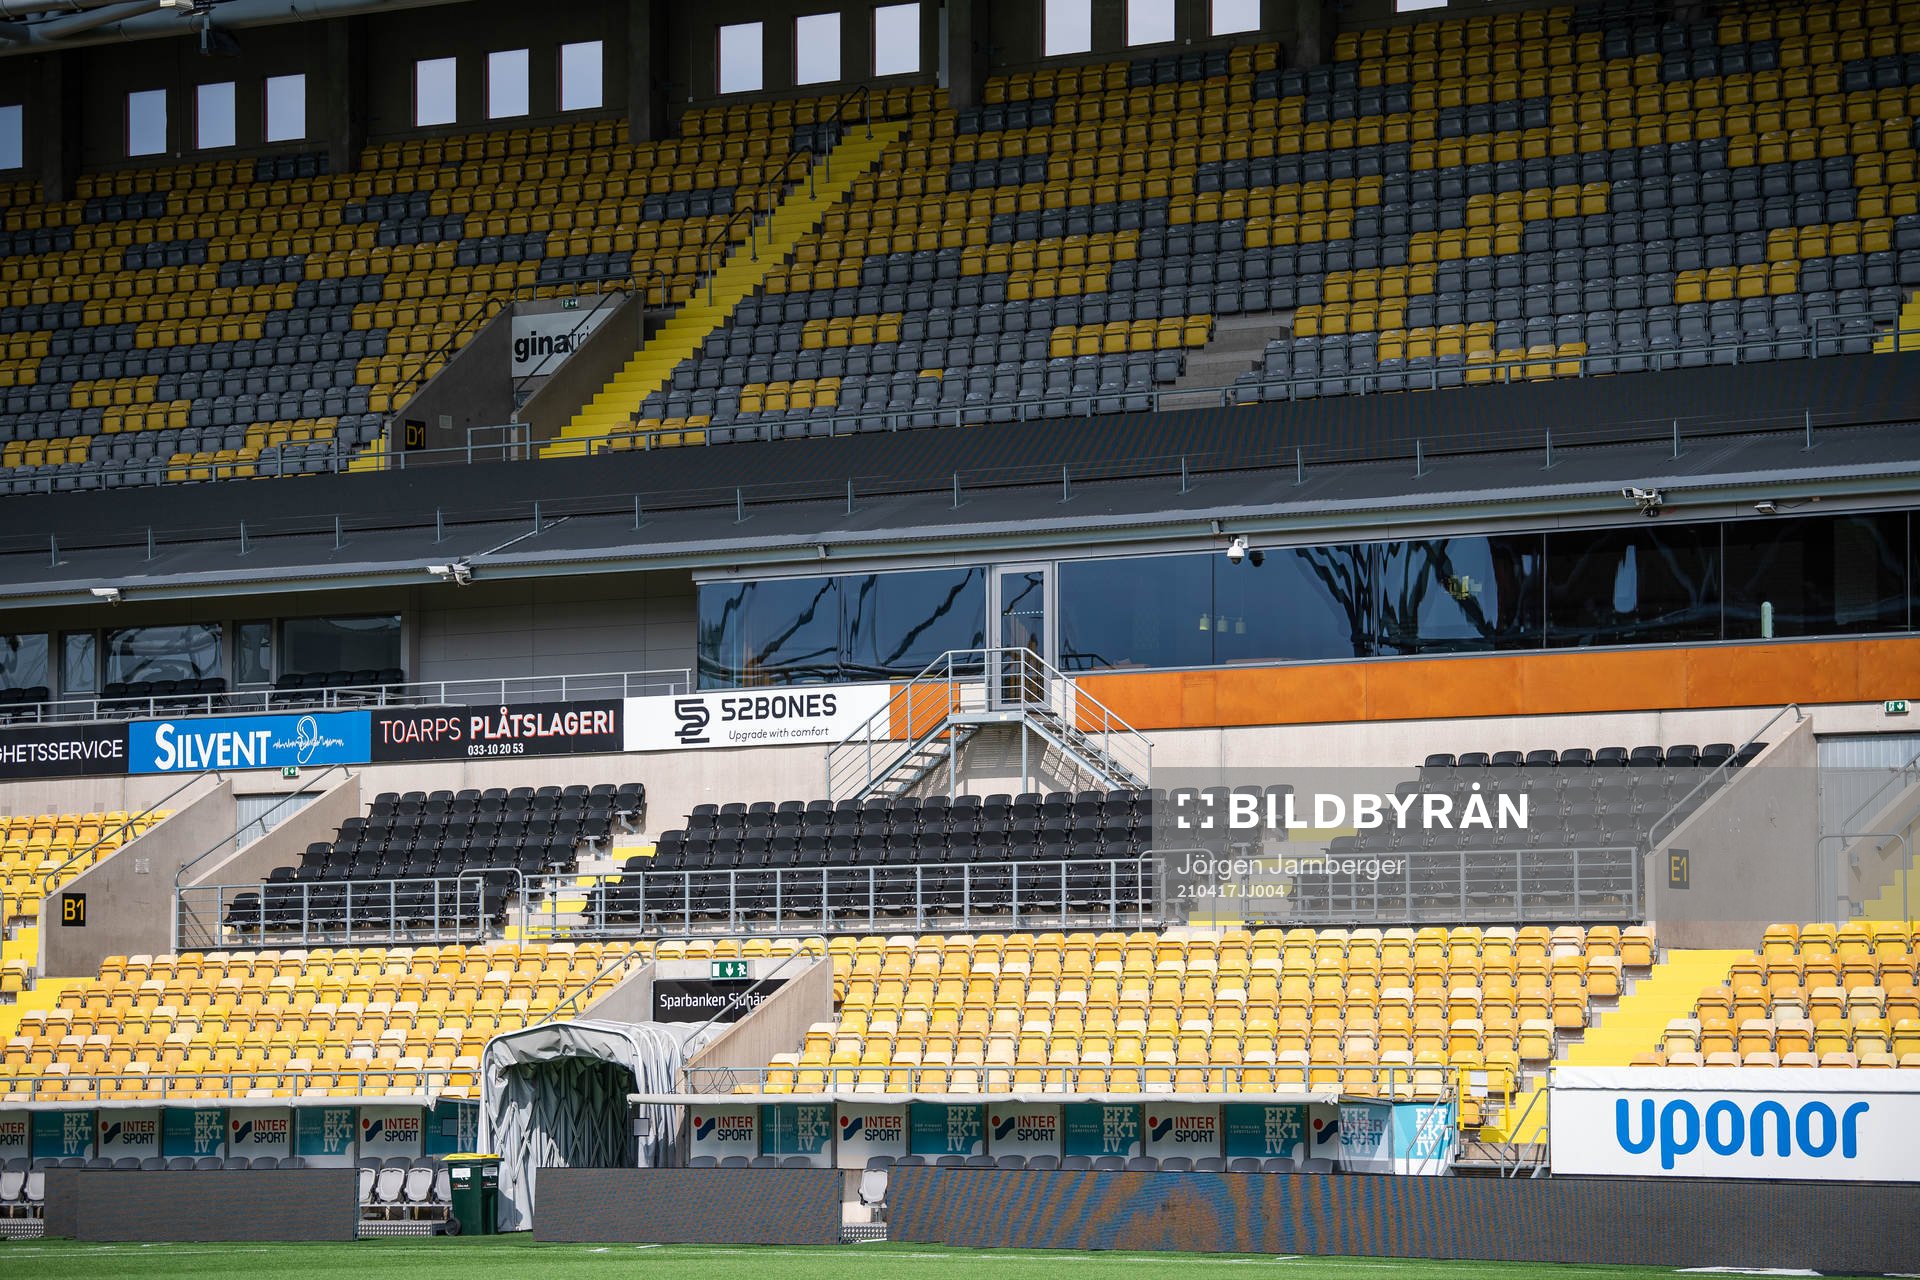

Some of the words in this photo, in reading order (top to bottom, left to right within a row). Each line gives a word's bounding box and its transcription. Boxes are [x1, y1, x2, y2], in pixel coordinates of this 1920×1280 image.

[406, 424, 425, 447] D1
[721, 694, 837, 721] 52BONES
[380, 717, 463, 744] TOARPS
[470, 706, 615, 740] PLÅTSLAGERI
[728, 729, 768, 742] Upgrade
[769, 728, 789, 738] with
[791, 726, 829, 737] comfort
[154, 723, 272, 771] SILVENT
[467, 744, 498, 756] 033-10
[499, 743, 511, 755] 20
[512, 743, 524, 754] 53
[1671, 855, 1688, 882] E1
[64, 898, 85, 921] B1
[660, 993, 726, 1009] Sparbanken
[728, 992, 769, 1010] Sjuhär
[64, 1113, 88, 1126] EFF
[194, 1112, 220, 1125] EFF
[324, 1110, 350, 1122] EFF
[798, 1106, 825, 1121] EFF
[948, 1106, 976, 1121] EFF
[1104, 1106, 1132, 1121] EFF
[1265, 1107, 1296, 1122] EFF
[123, 1120, 155, 1132] INTER
[254, 1120, 286, 1131] INTER
[384, 1118, 418, 1130] INTER
[718, 1116, 753, 1128] INTER
[798, 1121, 829, 1136] EKT
[865, 1116, 901, 1128] INTER
[948, 1121, 980, 1136] EKT
[1018, 1116, 1055, 1128] INTER
[1175, 1116, 1214, 1129] INTER
[64, 1126, 92, 1140] EKT
[194, 1125, 222, 1139] EKT
[324, 1123, 352, 1138] EKT
[384, 1130, 418, 1142] SPORT
[718, 1128, 753, 1141] SPORT
[865, 1128, 901, 1141] SPORT
[1018, 1128, 1055, 1141] SPORT
[1104, 1122, 1136, 1137] EKT
[1175, 1130, 1214, 1143] SPORT
[1265, 1122, 1300, 1138] EKT
[1616, 1098, 1870, 1170] uponor
[123, 1133, 154, 1145] SPORT
[254, 1132, 286, 1144] SPORT
